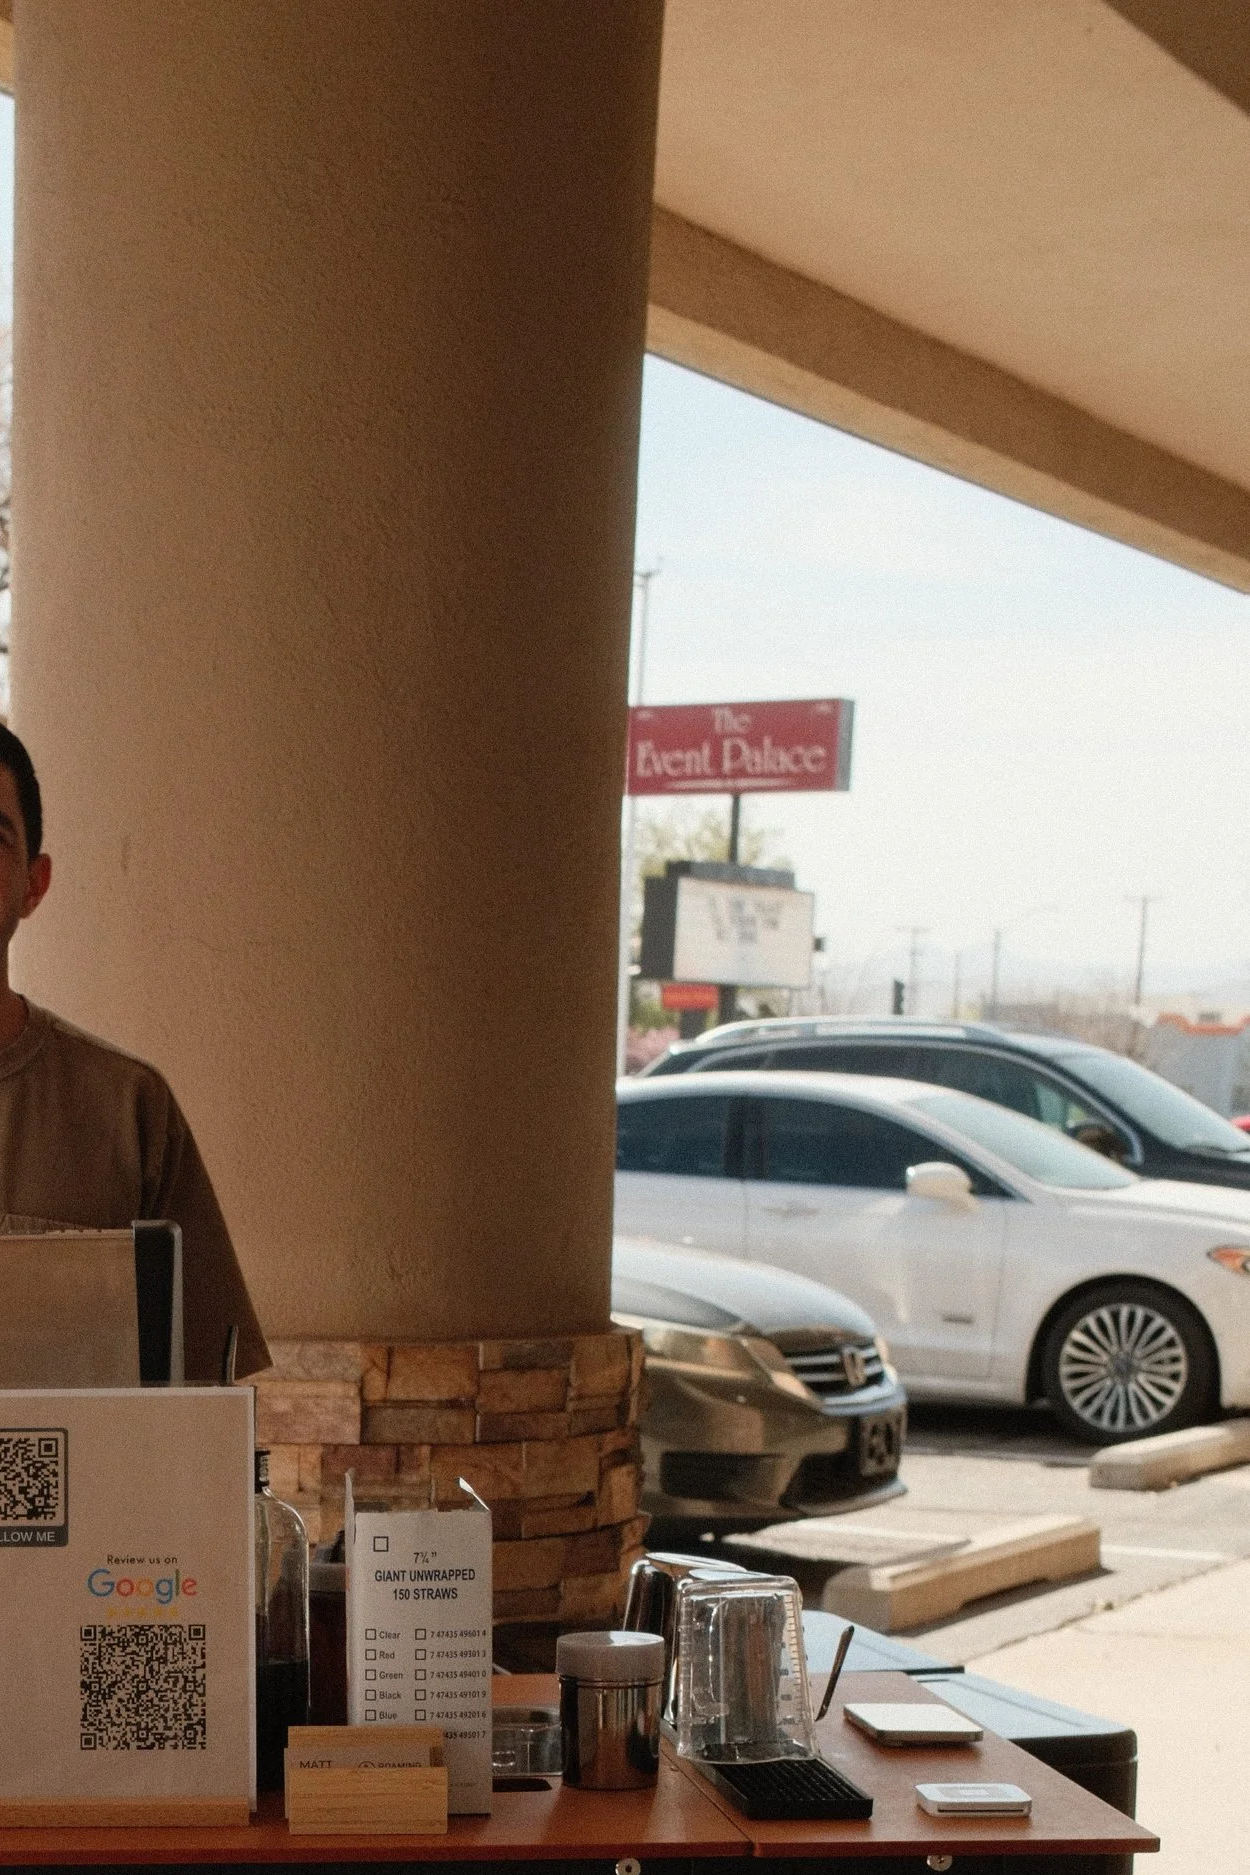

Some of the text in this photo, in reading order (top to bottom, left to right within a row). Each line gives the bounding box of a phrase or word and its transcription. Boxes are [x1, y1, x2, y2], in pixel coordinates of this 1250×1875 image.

[713, 706, 750, 734] The
[636, 735, 826, 777] Event Palace
[36, 1531, 56, 1542] ME
[107, 1555, 178, 1565] Review us on
[375, 1568, 476, 1582] GIANT UNWRAPPED
[87, 1568, 198, 1604] Google
[393, 1587, 458, 1600] 150 STRAWS
[379, 1631, 401, 1639] Clear
[379, 1651, 395, 1659] Red
[379, 1671, 403, 1680] Green
[379, 1691, 402, 1700] Black
[379, 1711, 398, 1720] Blue
[300, 1760, 332, 1768] MATT
